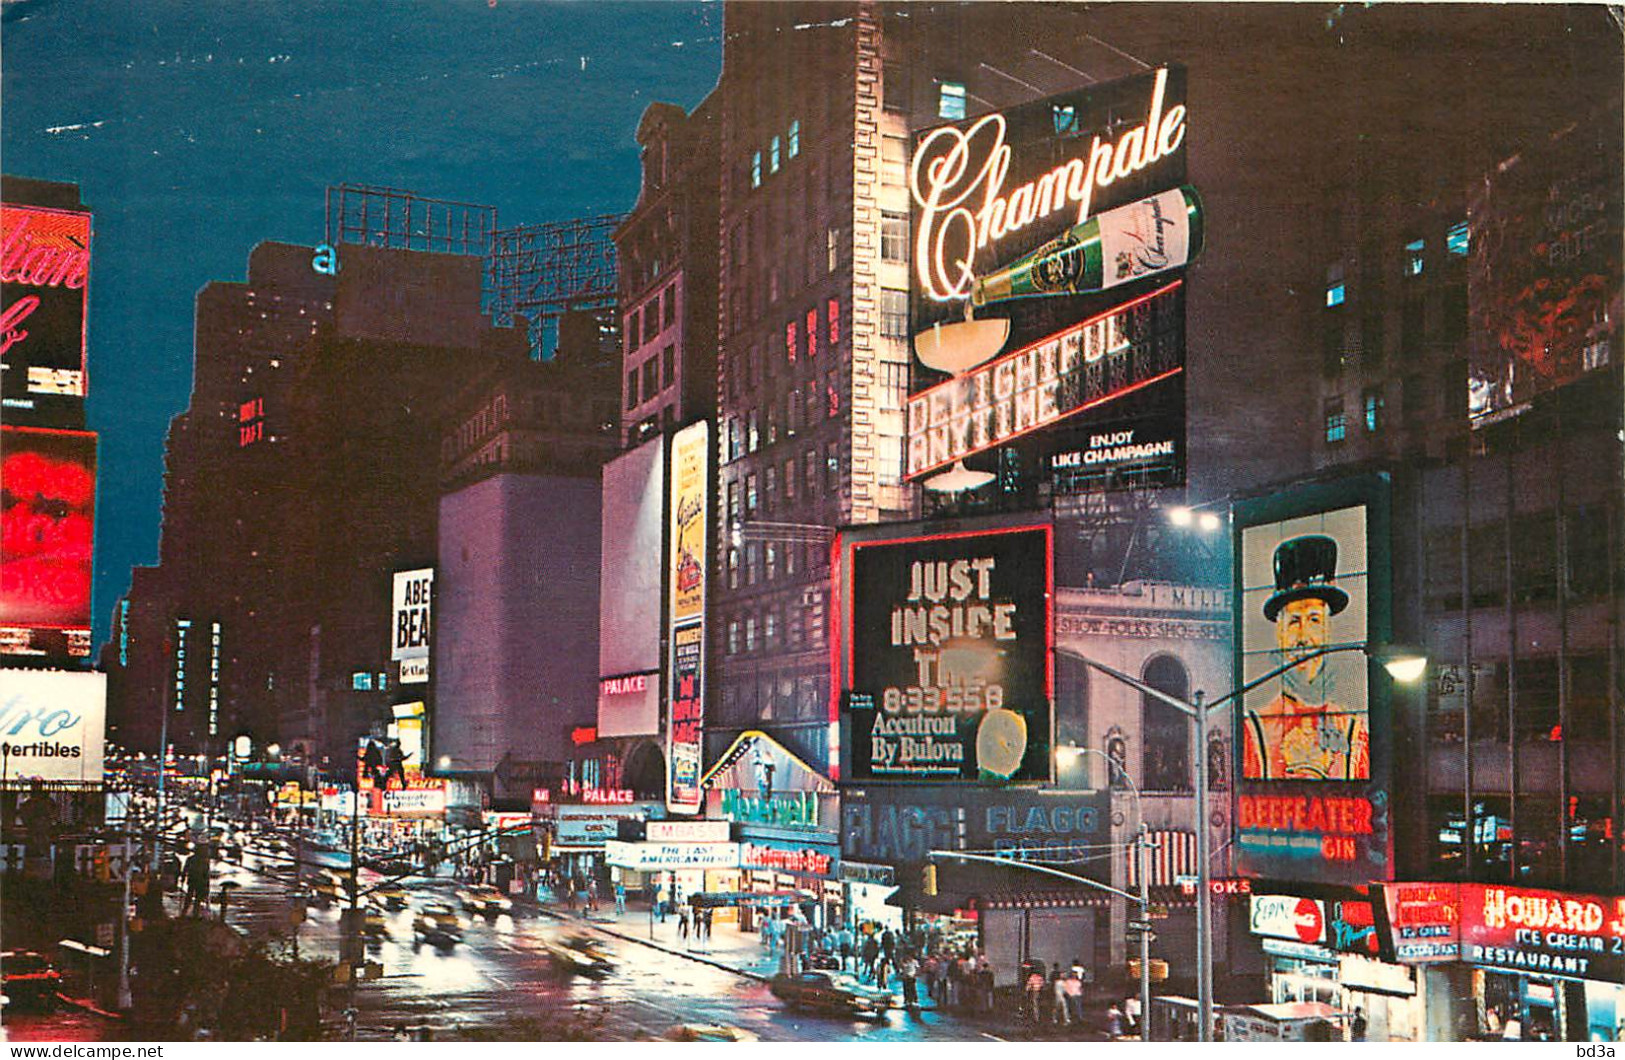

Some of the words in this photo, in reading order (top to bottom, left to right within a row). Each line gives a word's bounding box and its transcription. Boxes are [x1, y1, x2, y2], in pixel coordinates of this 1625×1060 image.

[911, 67, 1186, 301] Champale
[909, 314, 1131, 436] DELIGHTFUL
[908, 378, 1060, 474] ANYTIME
[1052, 453, 1081, 468] LIKE
[1083, 441, 1175, 465] CHAMPAGNE
[1090, 431, 1134, 450] ENJOY
[404, 579, 428, 605] ABE
[907, 557, 995, 602] JUST
[397, 608, 429, 648] BEA
[891, 603, 1017, 646] INSIDE
[175, 629, 186, 710] VICTORIA
[604, 676, 646, 694] PALACE
[872, 712, 957, 737] Accutron
[872, 737, 898, 767] By
[900, 736, 964, 762] Bulova
[583, 790, 634, 803] PALACE
[987, 806, 1097, 834] FLAGG
[1239, 795, 1373, 834] BEEFEATER
[1321, 836, 1357, 861] GIN
[1182, 881, 1251, 894] BOKS
[1484, 889, 1604, 932] HOWARD
[1515, 928, 1541, 946] ICE
[1472, 945, 1590, 973] RESTAURANT
